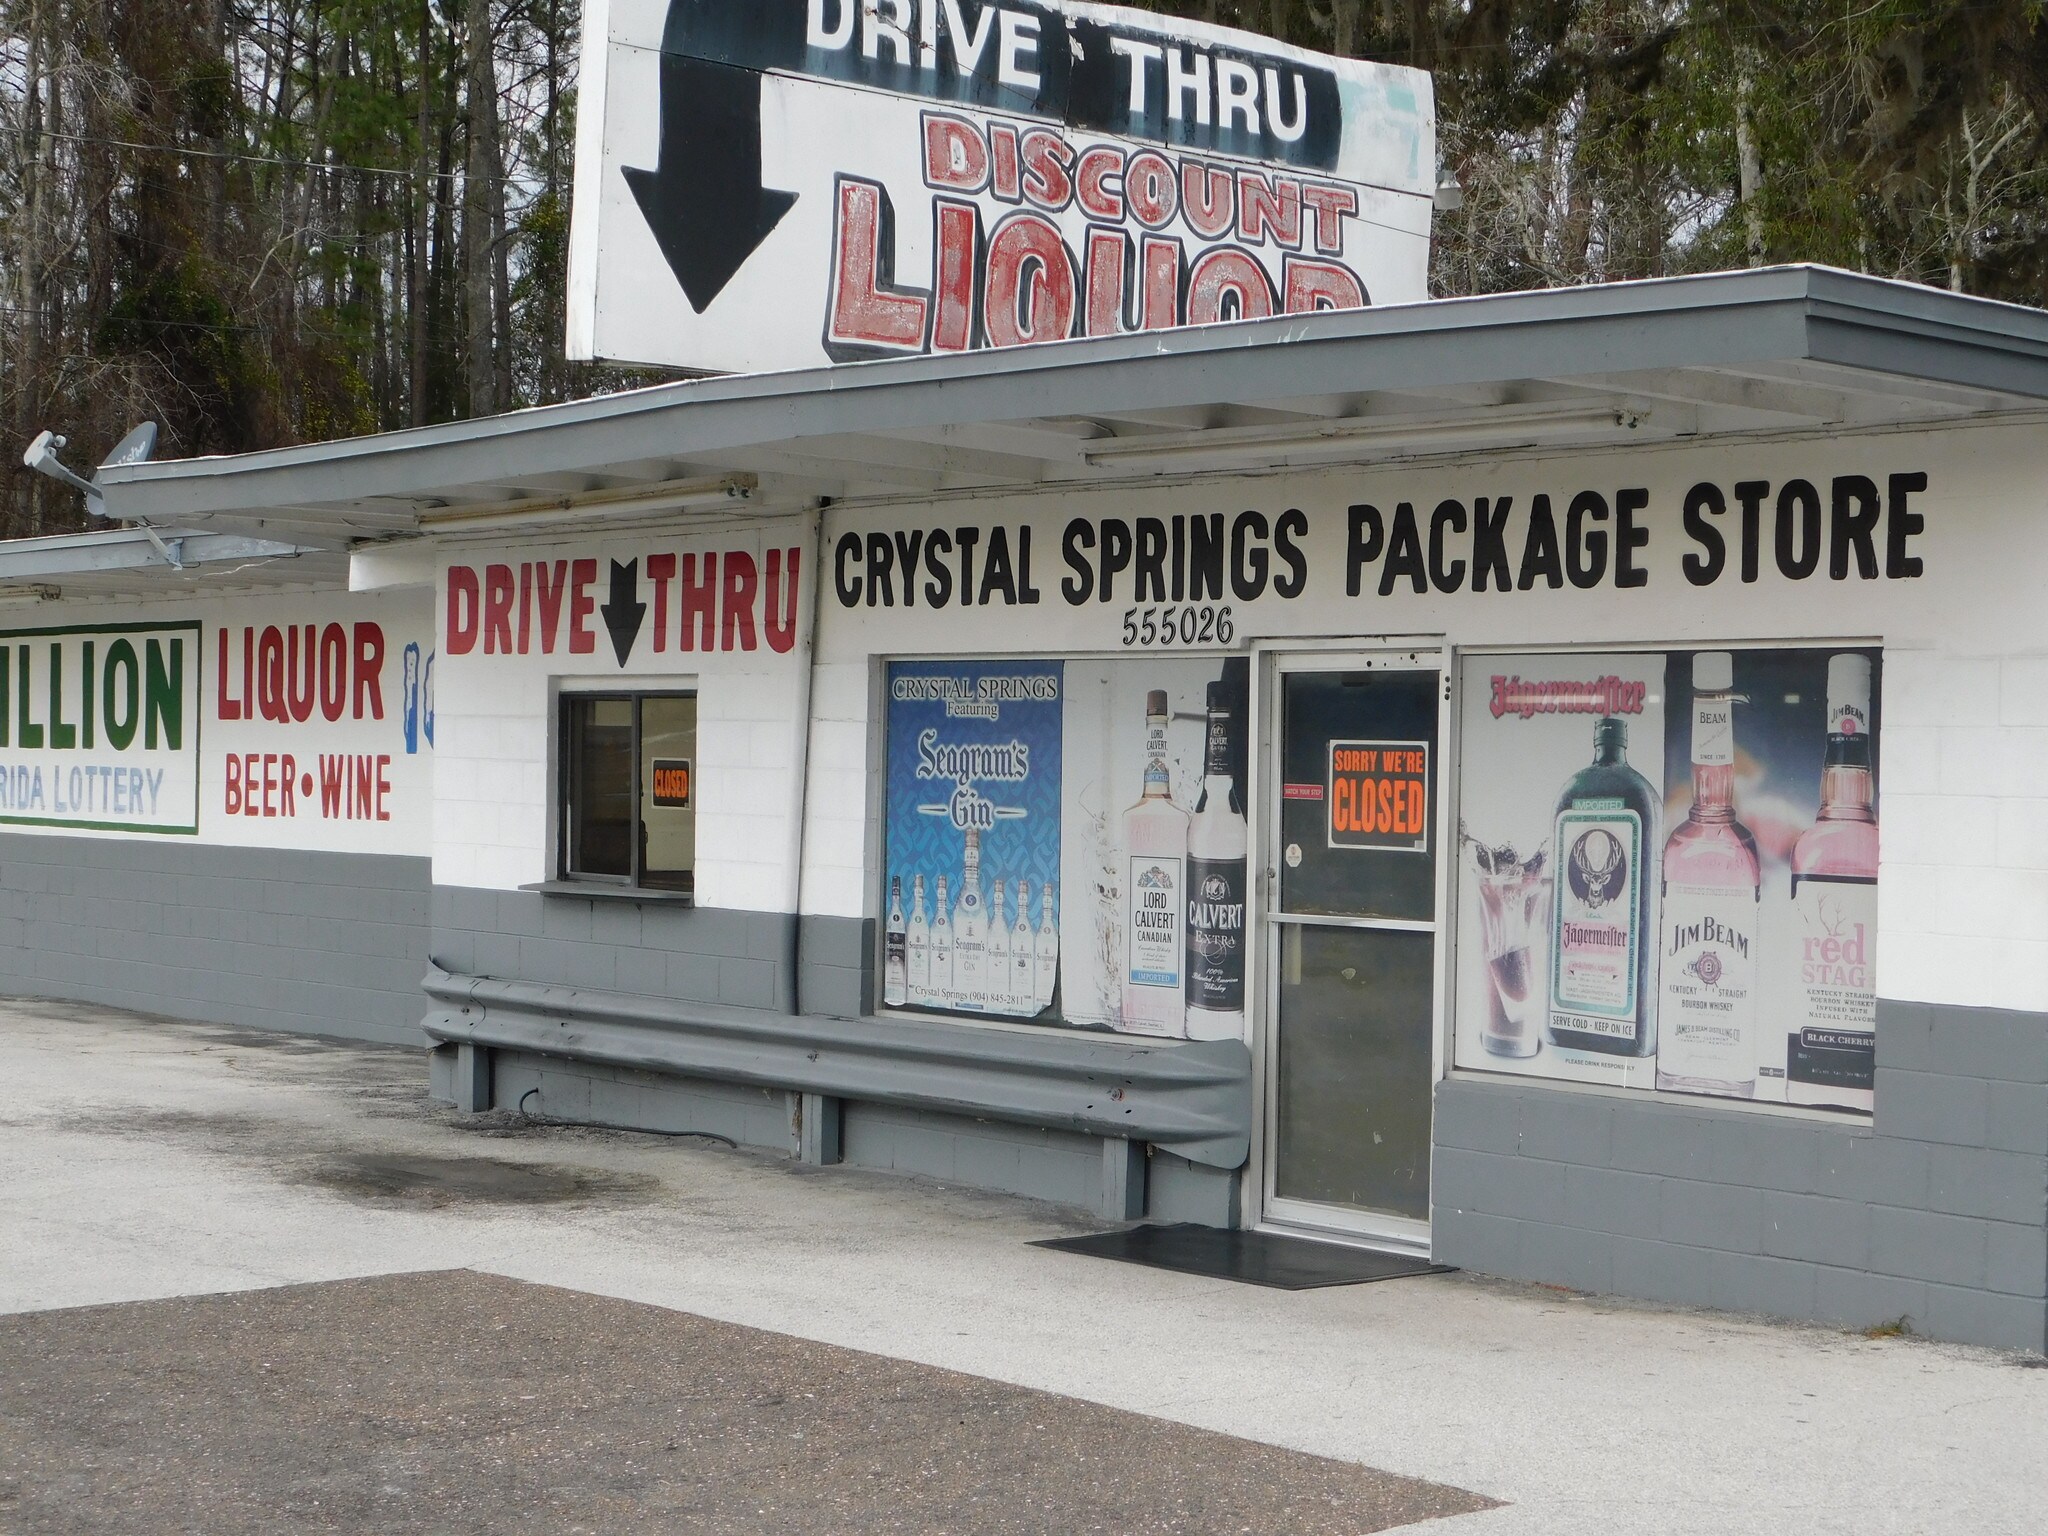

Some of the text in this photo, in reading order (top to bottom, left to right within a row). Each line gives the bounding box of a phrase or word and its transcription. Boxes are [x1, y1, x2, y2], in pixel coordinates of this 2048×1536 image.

[807, 0, 1308, 142] DRIVE THRU
[919, 109, 1360, 258] DISCOUNT
[834, 472, 1928, 609] CRYSTAL SPRINGS PACKAGE STORE
[446, 546, 801, 655] DRIVE THRU
[1122, 606, 1234, 646] 555026
[218, 622, 385, 724] LIQUOR
[893, 678, 1057, 699] CRYSTAL SPRINGS
[947, 701, 998, 719] Featuring
[1700, 711, 1727, 724] BEAM
[1150, 729, 1164, 739] LORD
[1146, 740, 1168, 751] CALVERT
[917, 730, 1028, 786] Seagram's
[1335, 750, 1424, 773] SORRY WE'RE
[54, 765, 164, 815] LOTTERY
[225, 753, 391, 822] BEER WINE
[655, 769, 688, 798] CLOSED
[951, 789, 993, 827] Gin
[1333, 777, 1424, 834] CLOSED
[1574, 800, 1623, 810] IMPORTED
[1143, 891, 1167, 909] LORD
[1135, 910, 1175, 930] CALVERT
[1189, 900, 1243, 930] CALVERT
[955, 937, 985, 952] Seagram's
[1137, 930, 1172, 944] CANADIAN
[1195, 930, 1236, 948] EXTRA
[1668, 916, 1749, 961] JIM BEAM
[1802, 922, 1867, 965] red
[1138, 973, 1170, 982] IMPORTED
[1802, 964, 1866, 988] STAG
[915, 985, 940, 997] Crystal
[941, 988, 968, 1002] Springs
[969, 991, 989, 1003] (904)
[990, 992, 1023, 1006] 845-2811
[1669, 985, 1747, 999] KENTUCKY STRAIGHT
[1807, 988, 1876, 1000] KENTUCKY STRAIGH
[1811, 996, 1875, 1008] BOURBON WHISKEY
[1681, 999, 1733, 1011] BOURBON WHISKEY
[1850, 1006, 1868, 1014] WITH
[1552, 1015, 1632, 1036] SERVE COLD KEEP ON ICE
[1808, 1012, 1841, 1021] NATURAL
[1807, 1033, 1876, 1047] BLACK CHERRY
[1565, 1058, 1584, 1066] PLEASE
[1584, 1059, 1601, 1067] DRINK
